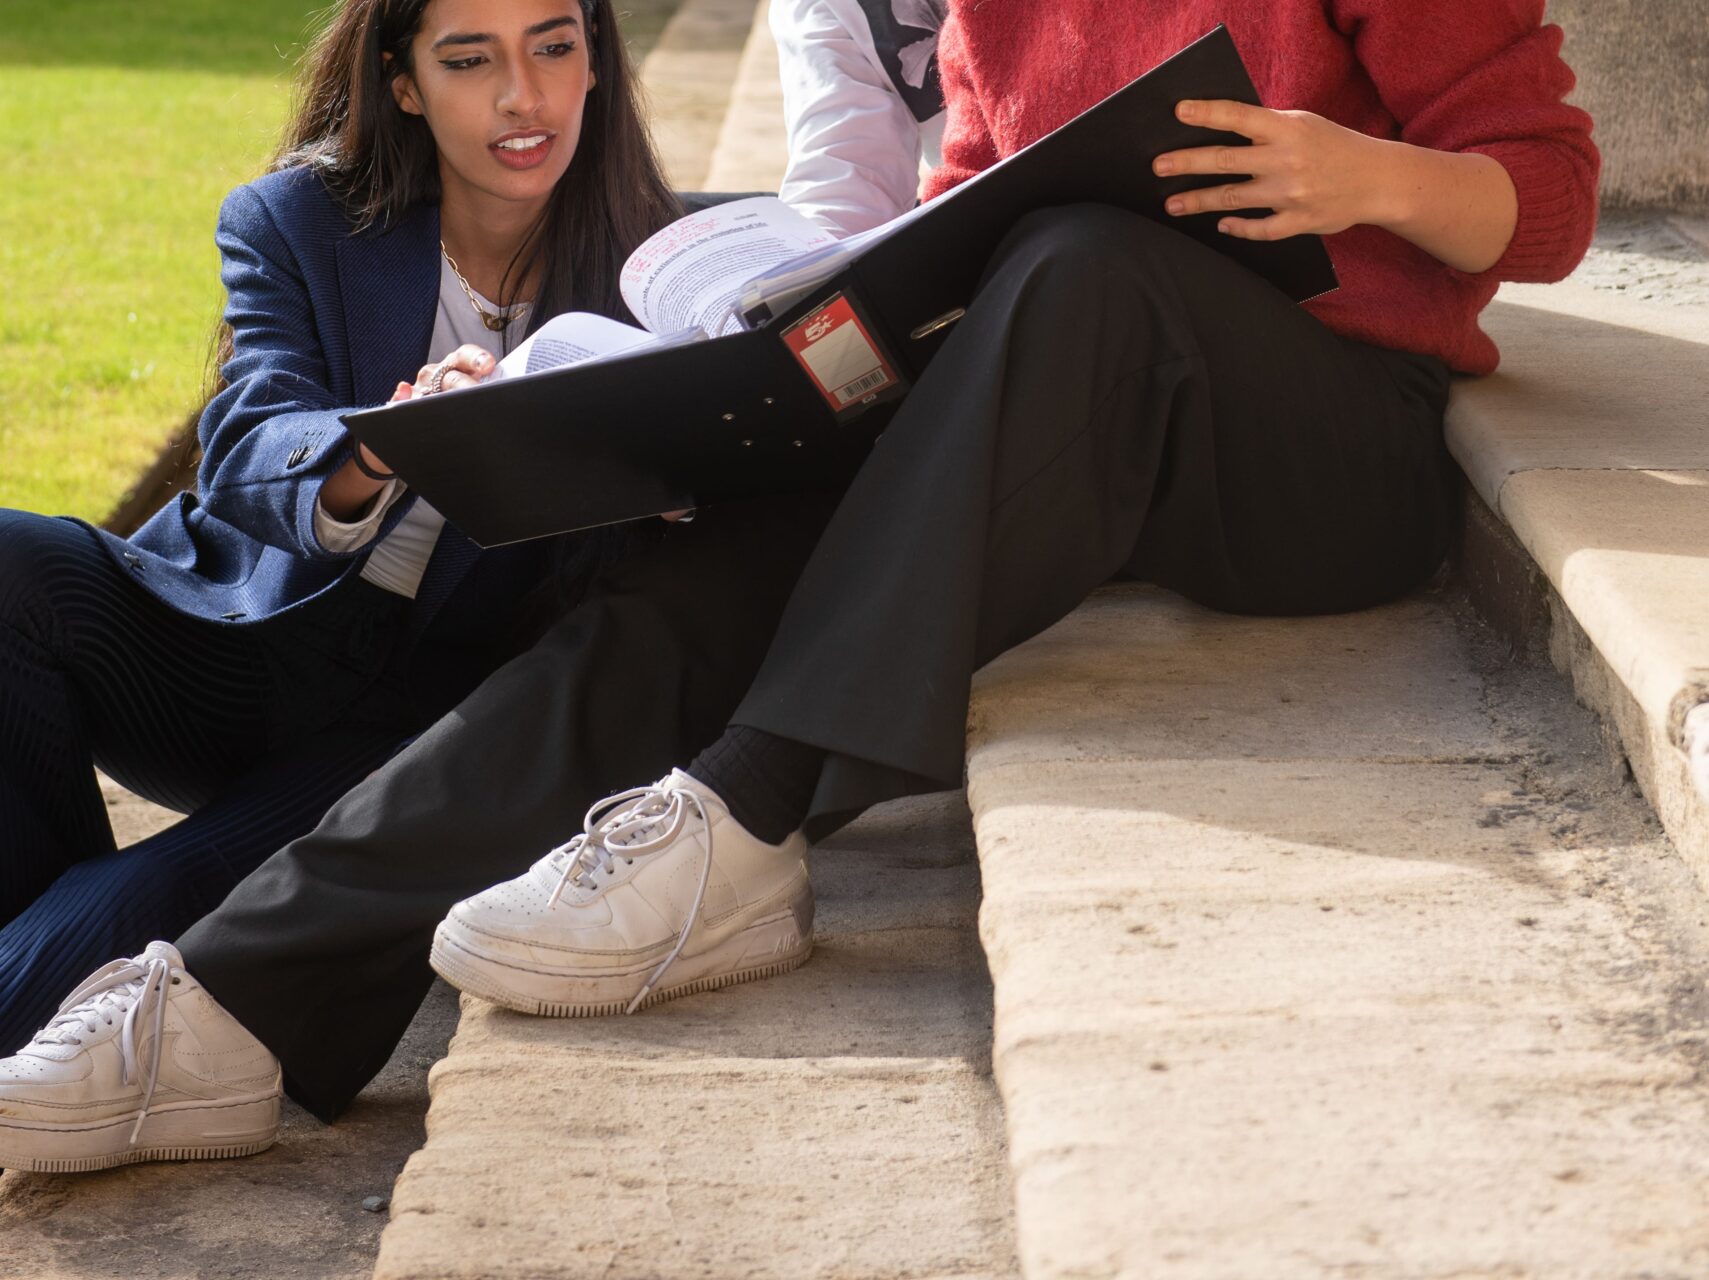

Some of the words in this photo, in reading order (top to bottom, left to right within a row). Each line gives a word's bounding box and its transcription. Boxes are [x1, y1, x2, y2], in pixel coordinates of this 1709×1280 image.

[654, 248, 687, 275] extinction
[710, 227, 744, 239] evolution
[774, 935, 796, 952] AIR
